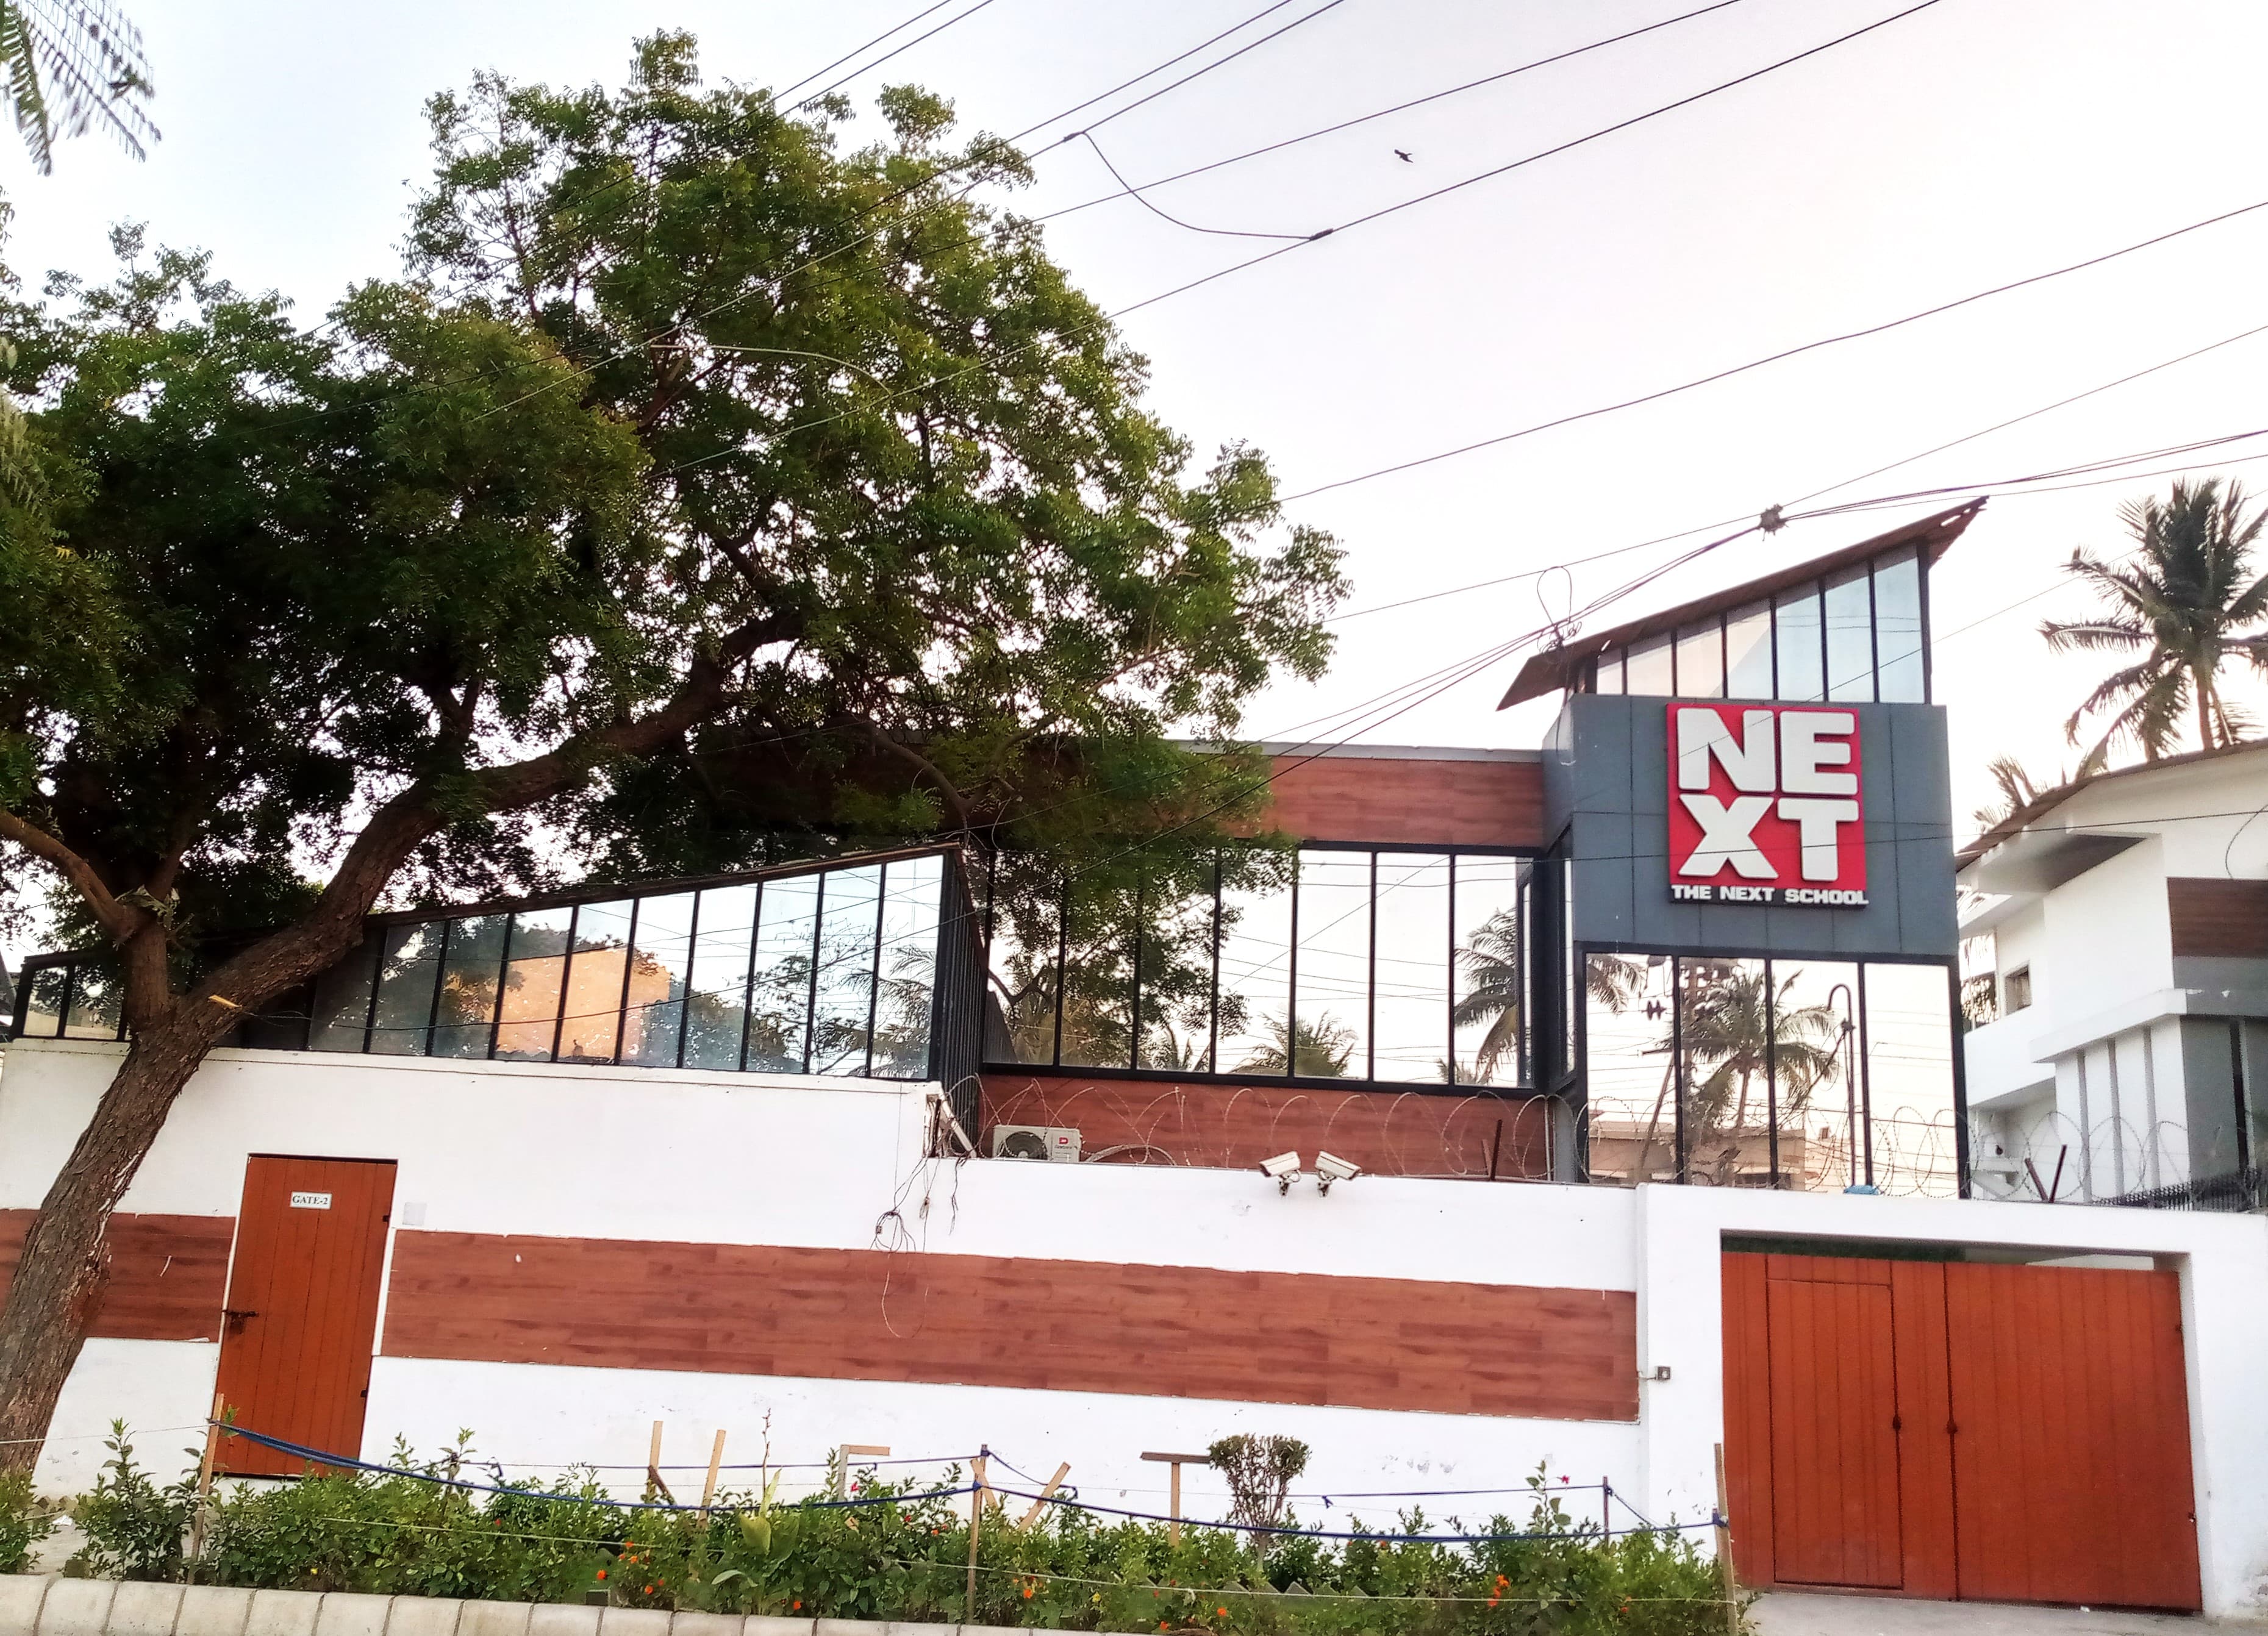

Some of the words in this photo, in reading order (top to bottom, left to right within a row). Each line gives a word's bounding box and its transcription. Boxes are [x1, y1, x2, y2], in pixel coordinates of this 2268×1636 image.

[1671, 884, 1712, 900] THE
[1719, 885, 1775, 902] NEXT
[1784, 888, 1869, 905] SCHOOL
[292, 1195, 328, 1205] GATE-2
